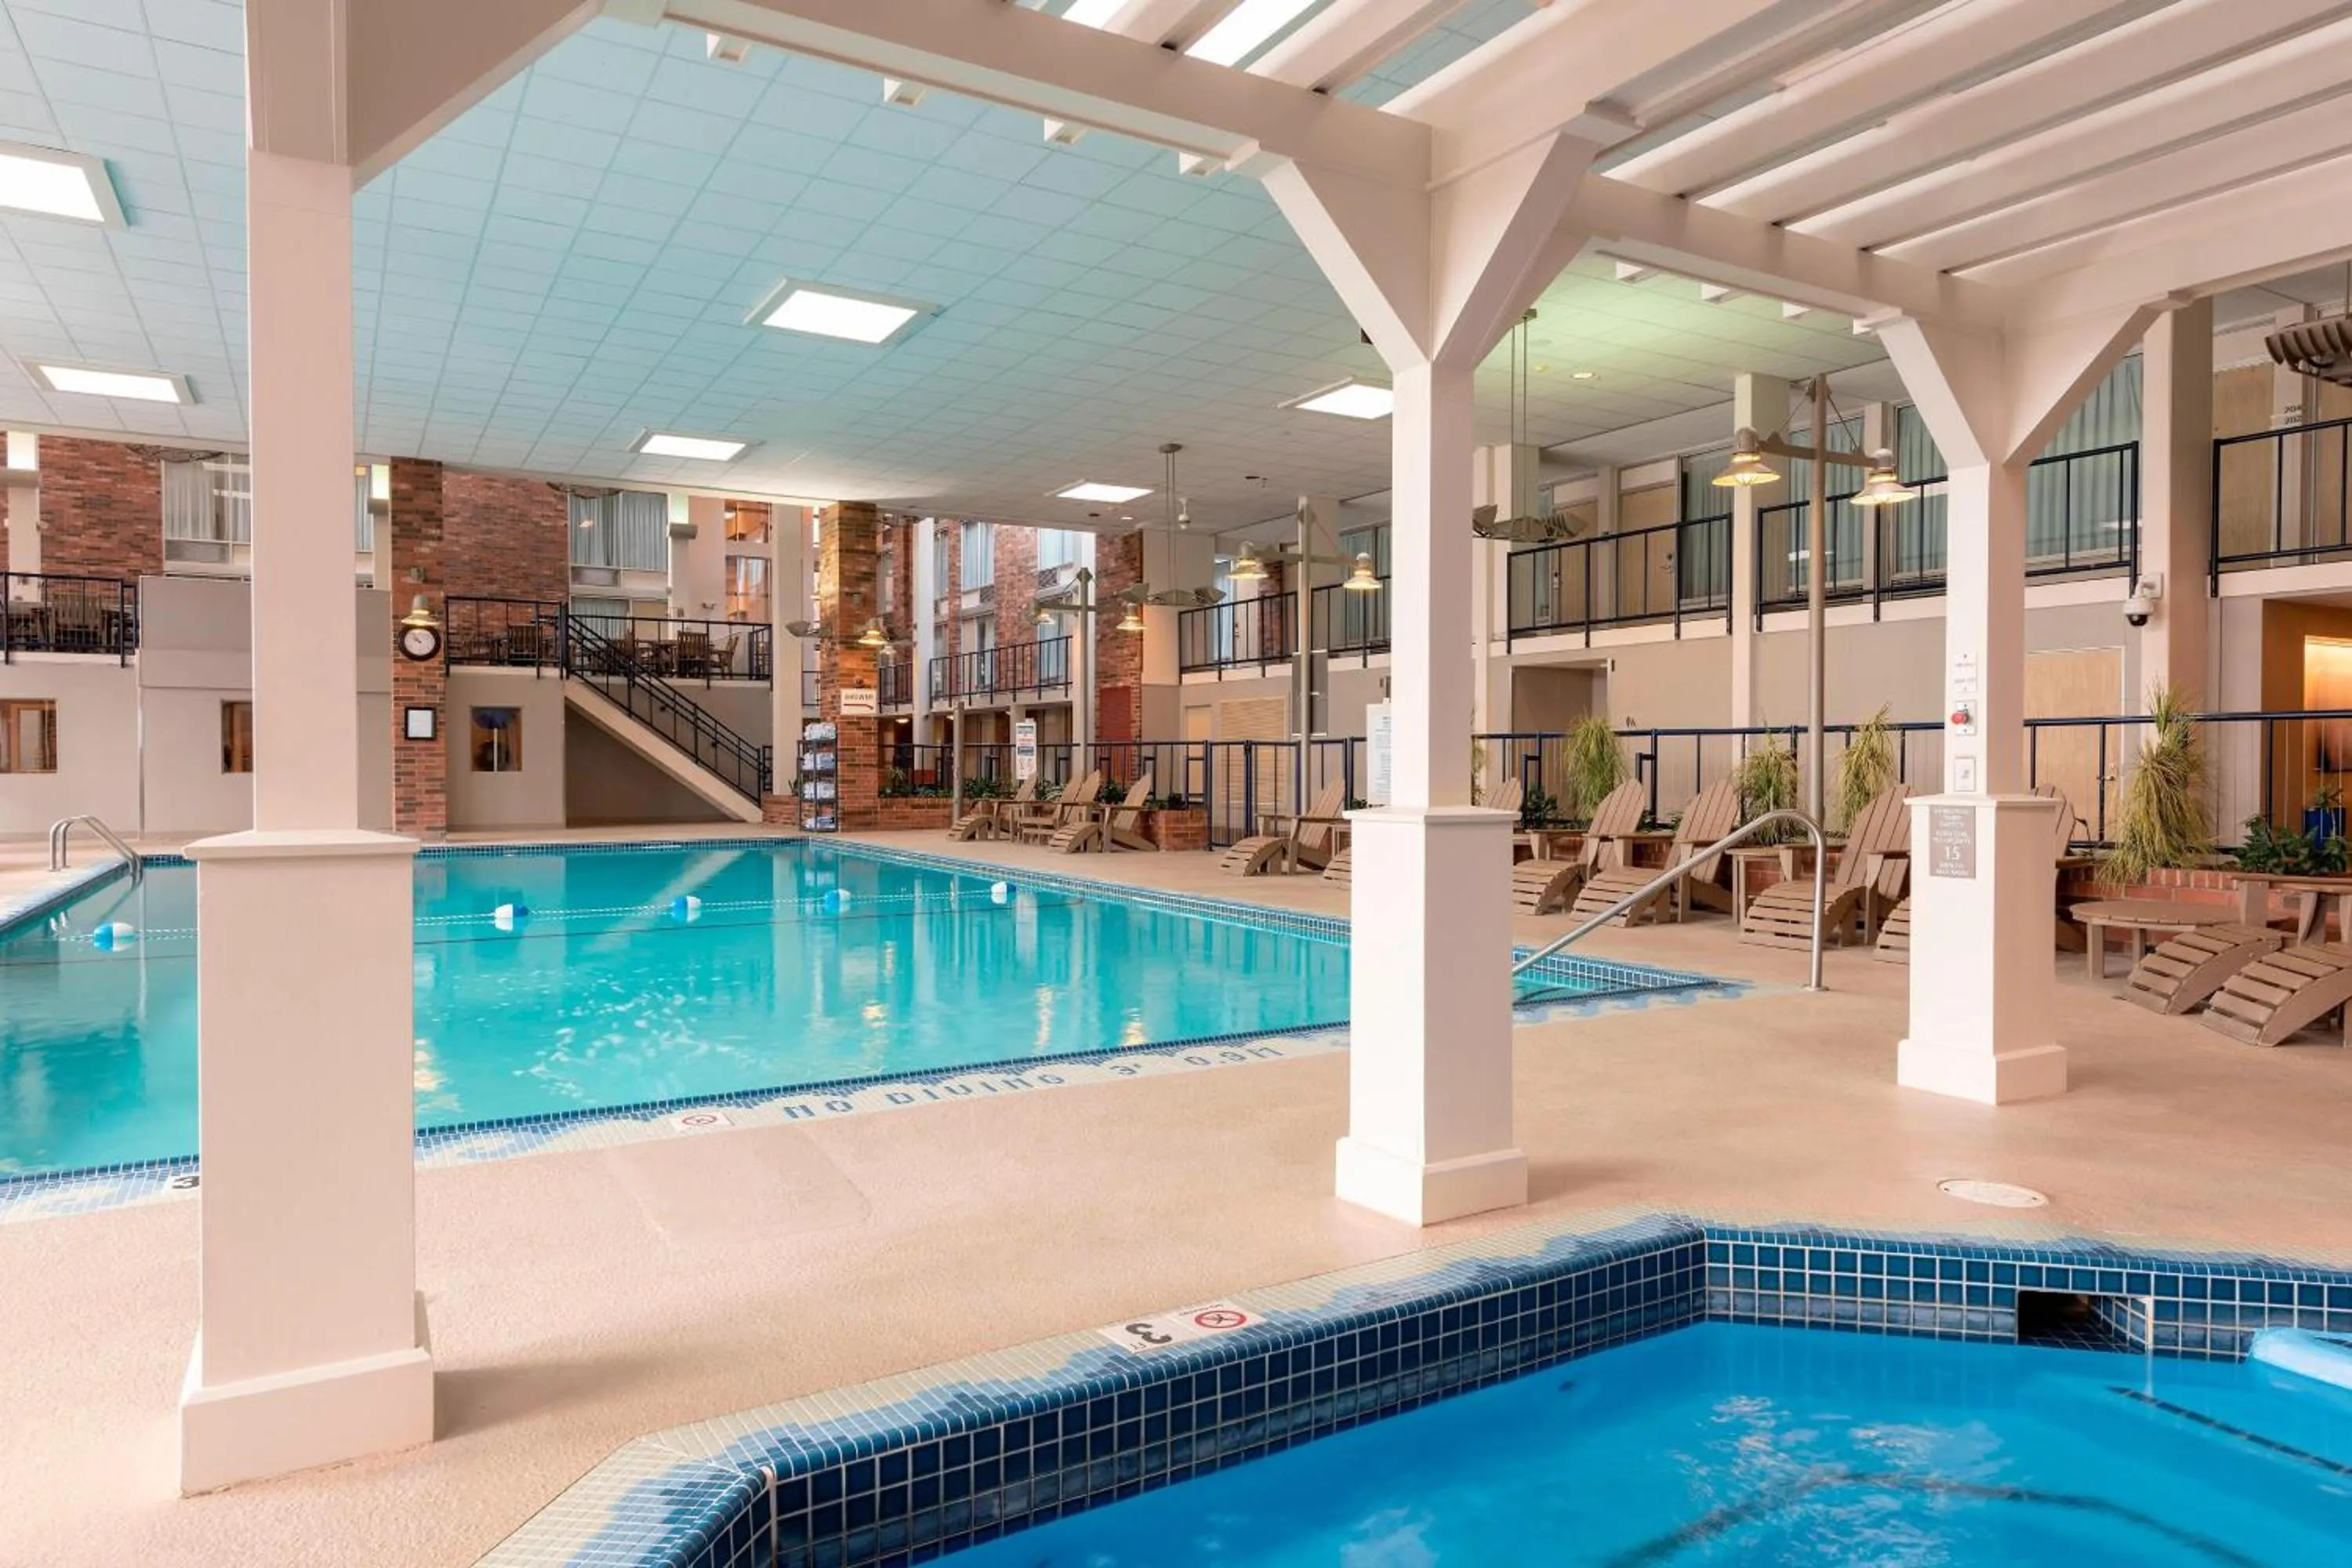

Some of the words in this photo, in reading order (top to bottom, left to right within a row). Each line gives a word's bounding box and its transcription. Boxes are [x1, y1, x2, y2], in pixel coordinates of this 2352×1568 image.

[1945, 846, 1961, 861] 15
[783, 1099, 854, 1119] NO
[885, 1073, 1065, 1105] DIVING
[1125, 1323, 1173, 1345] 3
